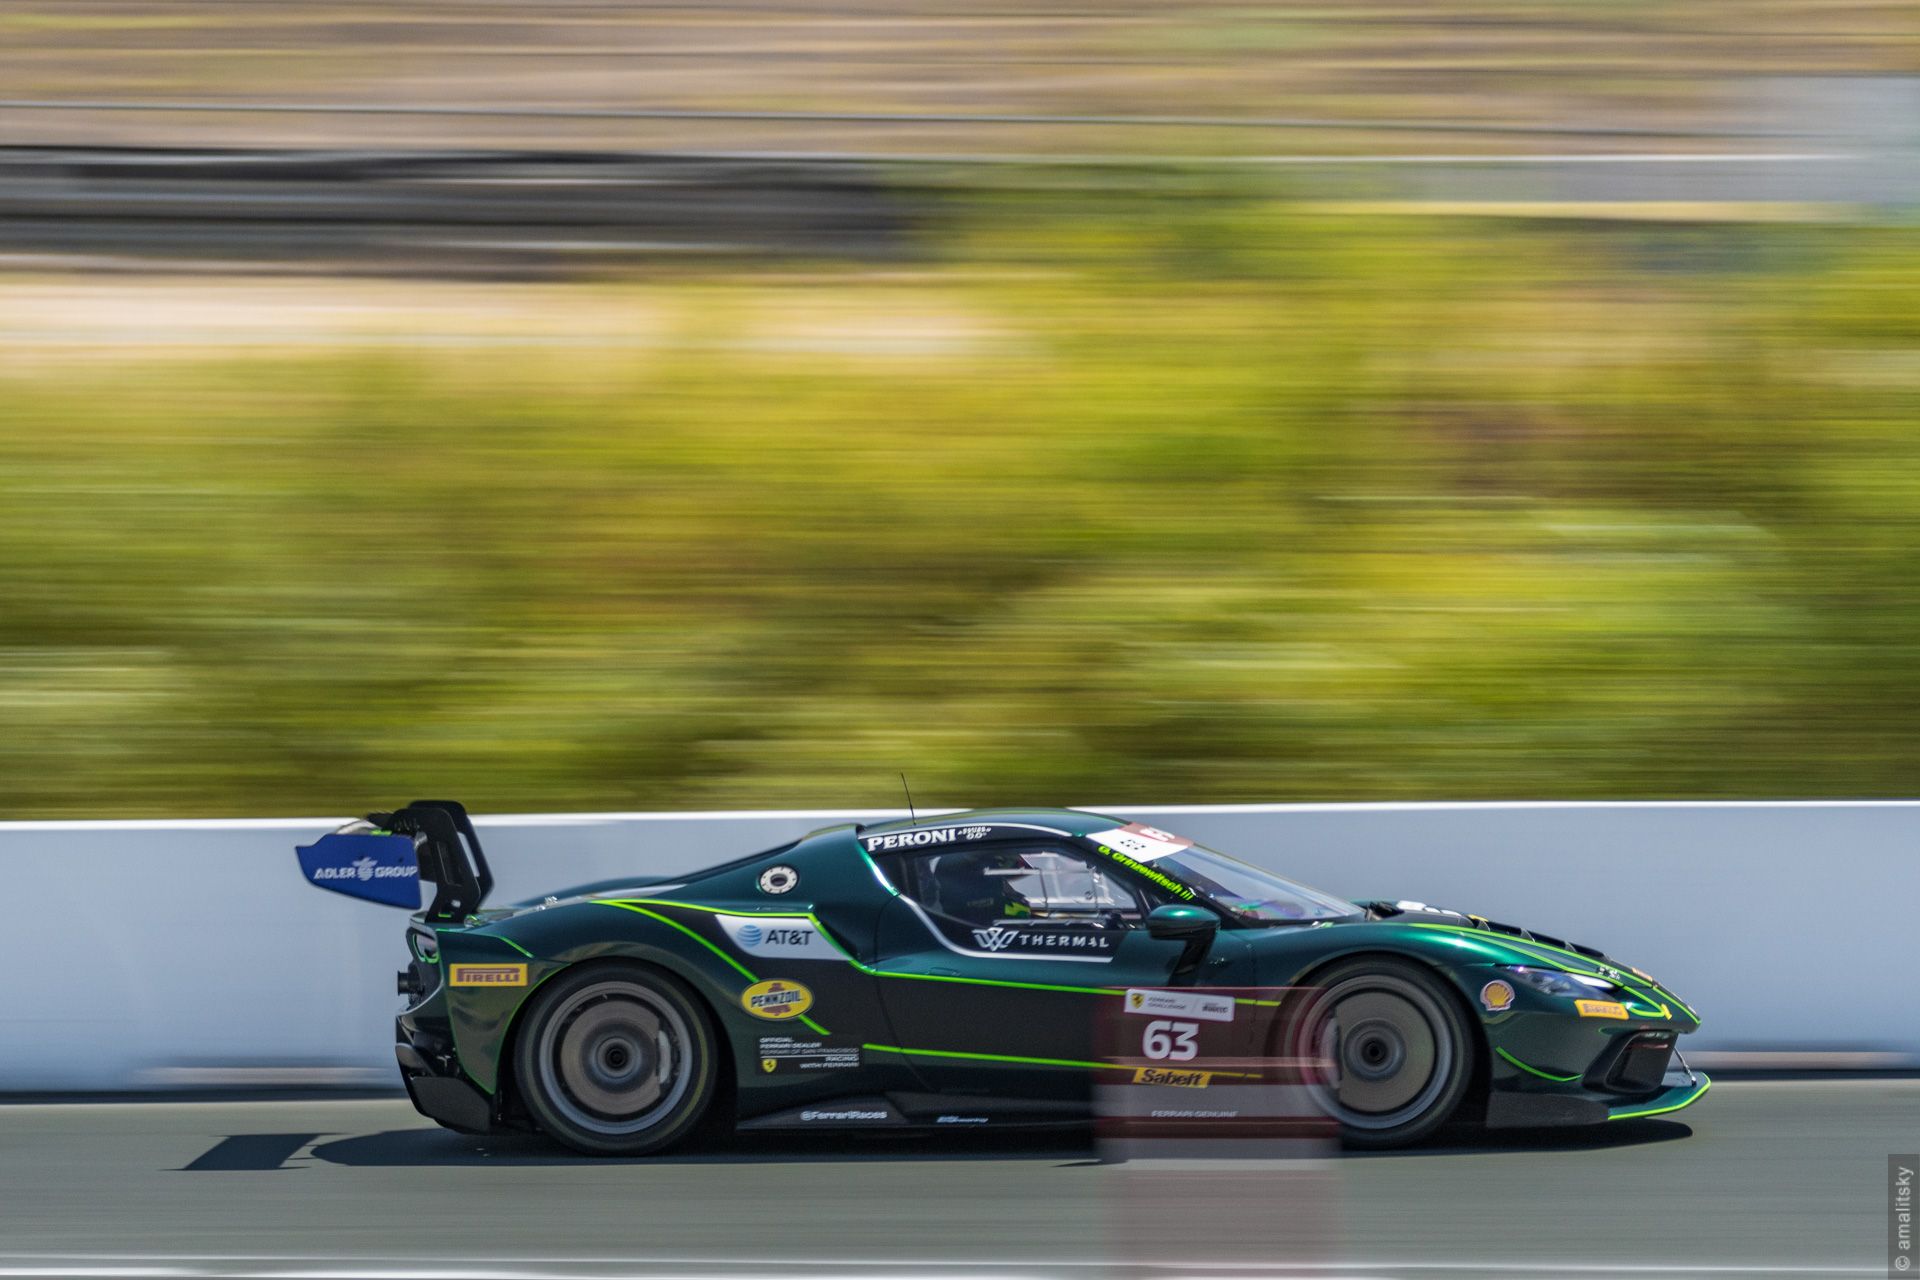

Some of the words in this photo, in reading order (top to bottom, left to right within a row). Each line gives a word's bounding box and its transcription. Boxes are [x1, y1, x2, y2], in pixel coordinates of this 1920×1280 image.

[867, 829, 956, 851] PERONI
[313, 867, 356, 879] ADLER
[374, 865, 418, 878] GROUP
[765, 930, 814, 945] AT&T
[1019, 934, 1109, 948] THERMAL
[456, 967, 521, 982] PIRELLI
[751, 990, 801, 1008] PENNZOIL
[1142, 1020, 1199, 1061] 63
[800, 1111, 887, 1121] @FerrariRaces
